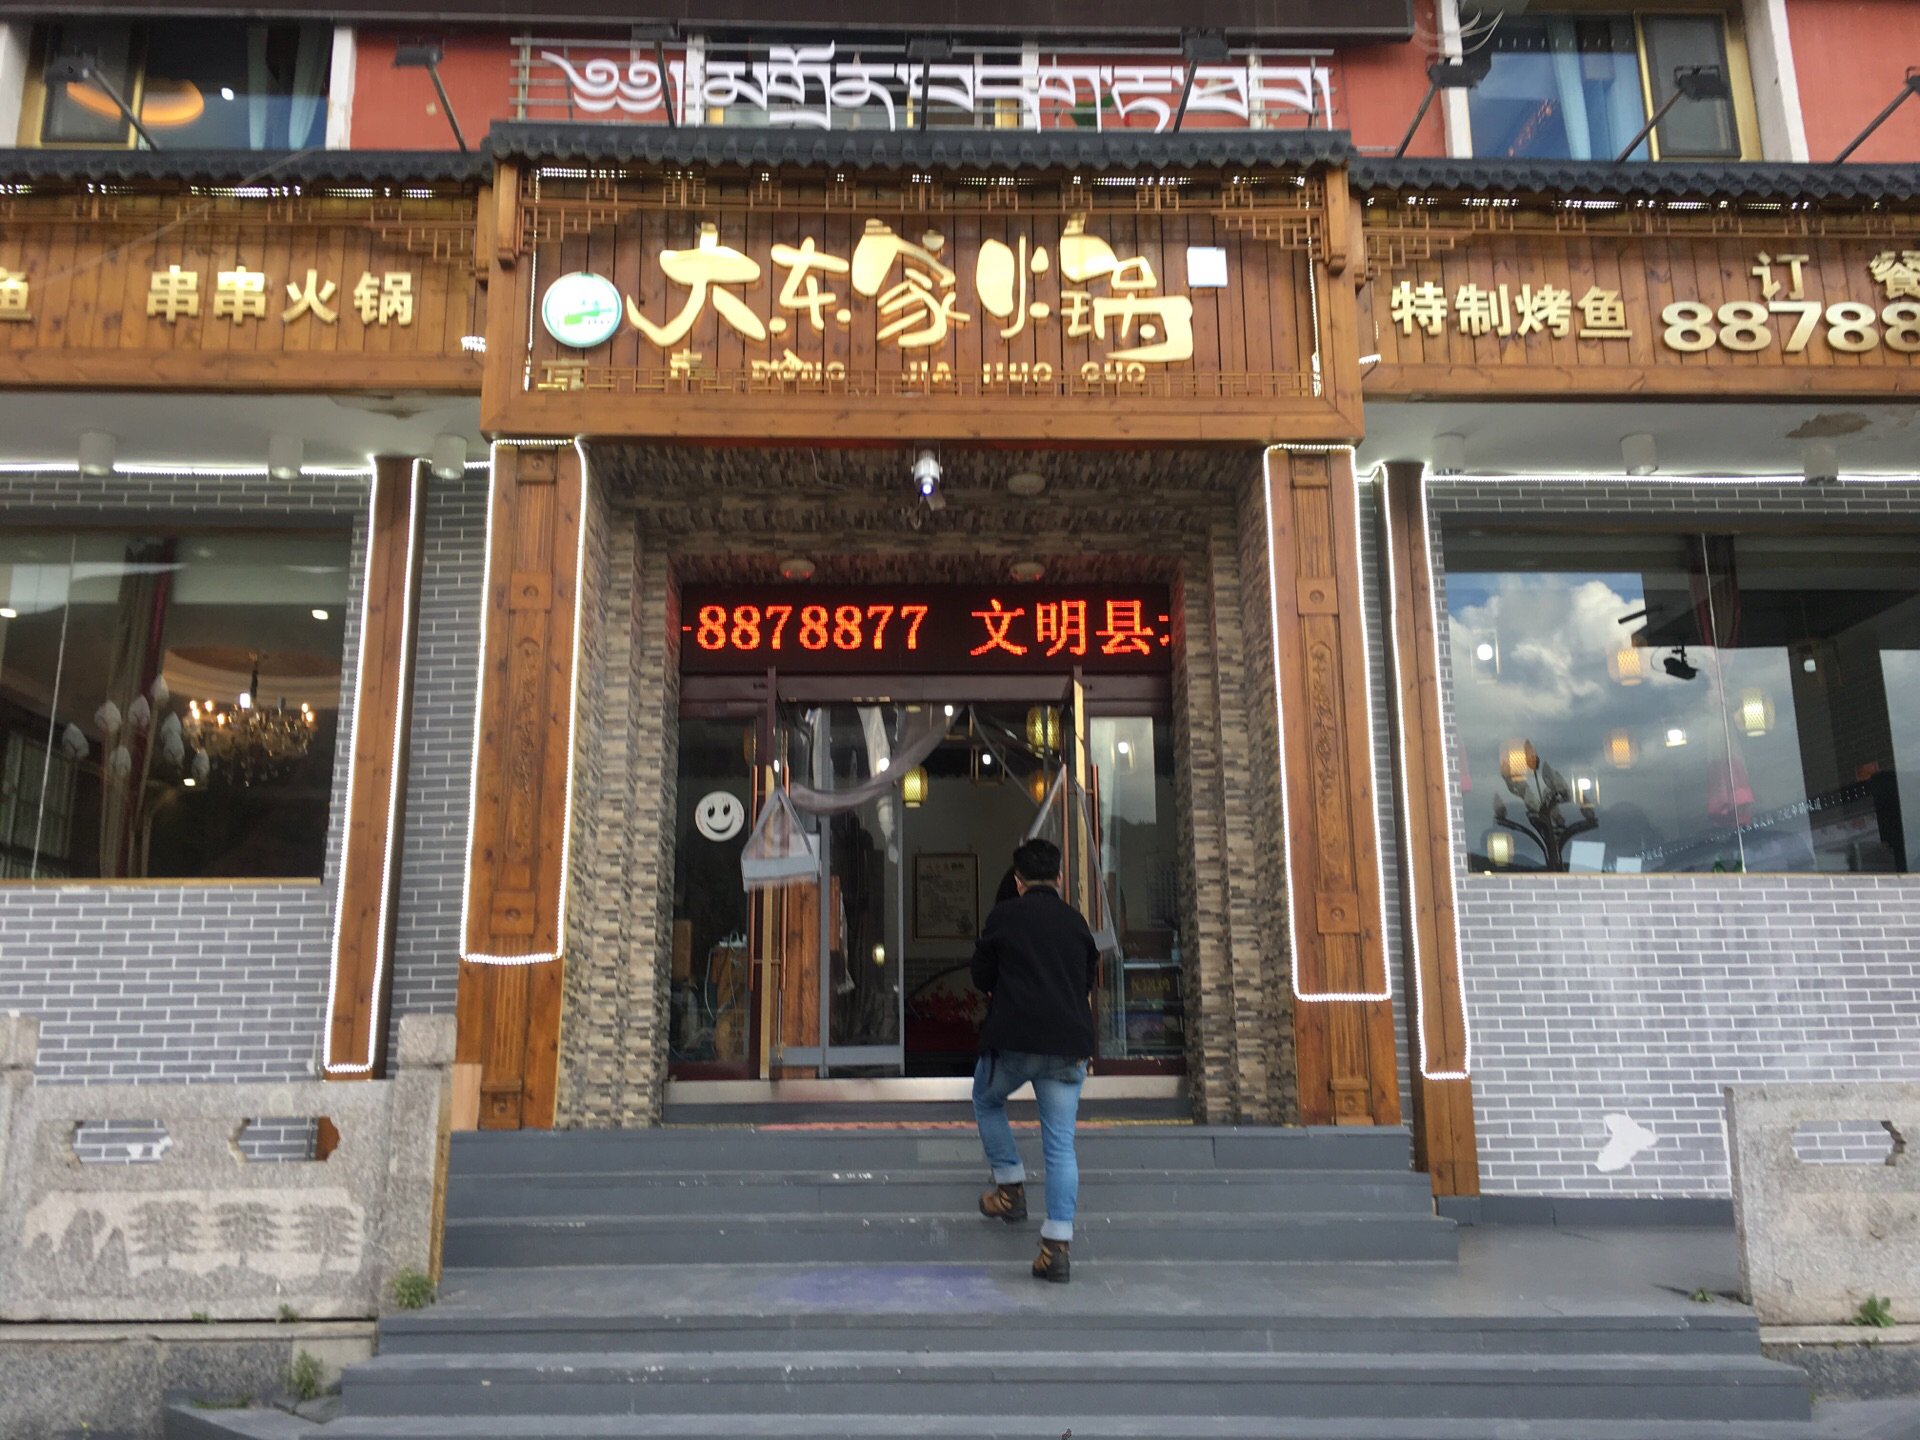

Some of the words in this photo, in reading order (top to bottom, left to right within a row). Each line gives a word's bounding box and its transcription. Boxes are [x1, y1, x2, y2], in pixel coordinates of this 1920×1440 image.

[146, 264, 414, 327] 串串火锅
[1390, 281, 1633, 340] 特制烤鱼
[1661, 301, 1920, 353] 88788
